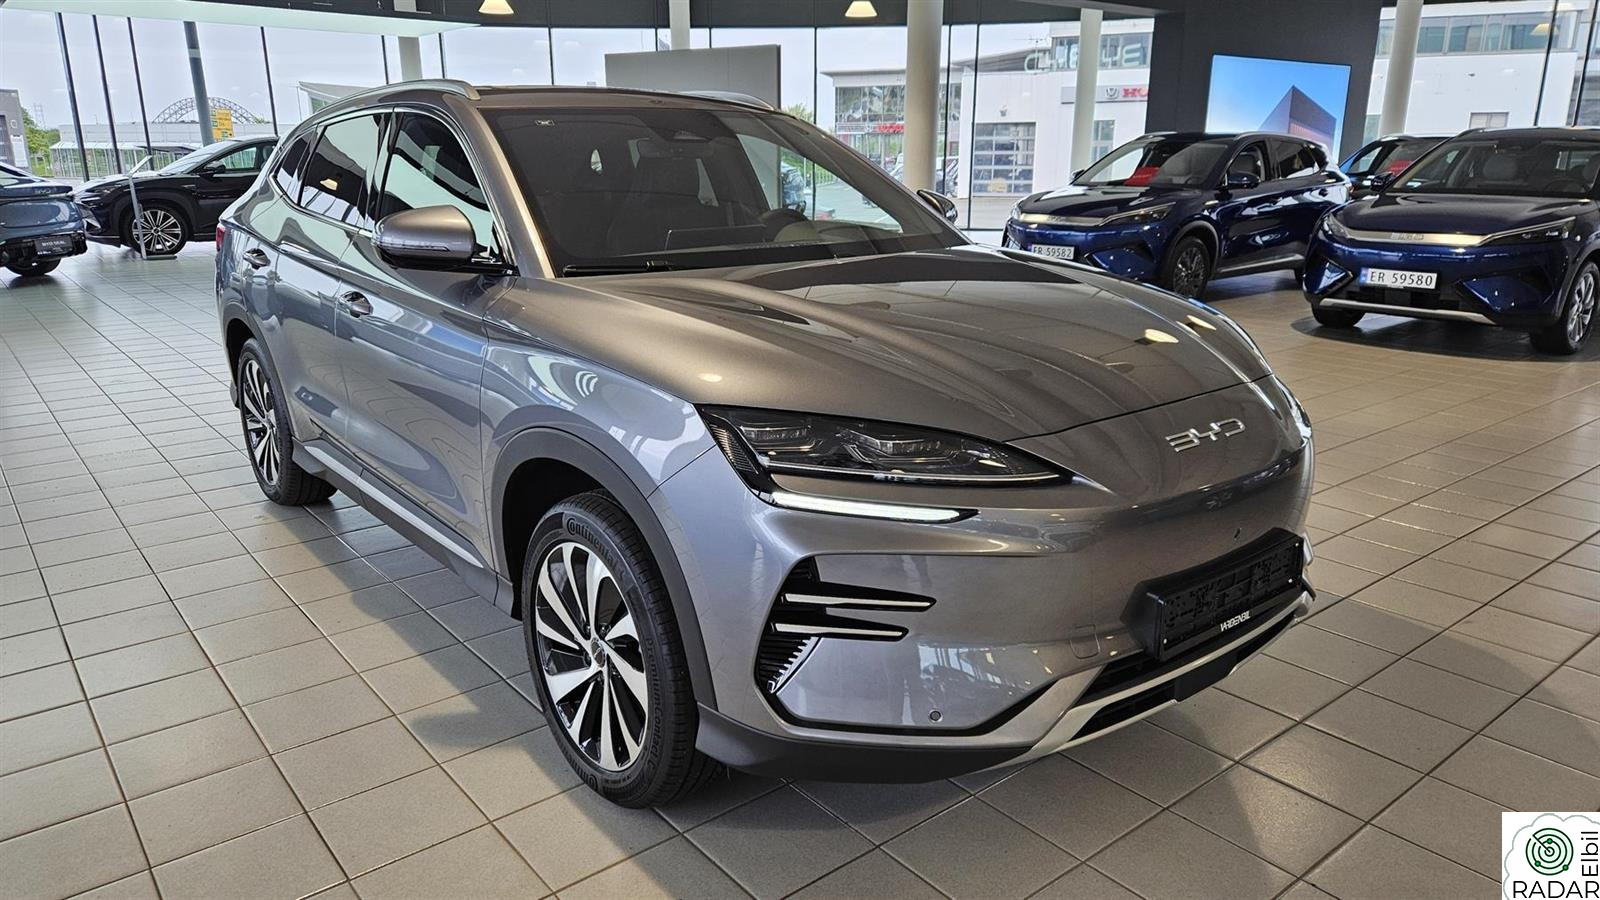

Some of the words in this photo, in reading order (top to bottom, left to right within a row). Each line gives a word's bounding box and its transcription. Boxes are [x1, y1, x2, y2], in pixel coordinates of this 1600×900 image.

[1046, 247, 1072, 258] 59582
[1370, 271, 1385, 282] ER
[1391, 272, 1433, 287] 59580
[1165, 418, 1246, 452] BYD
